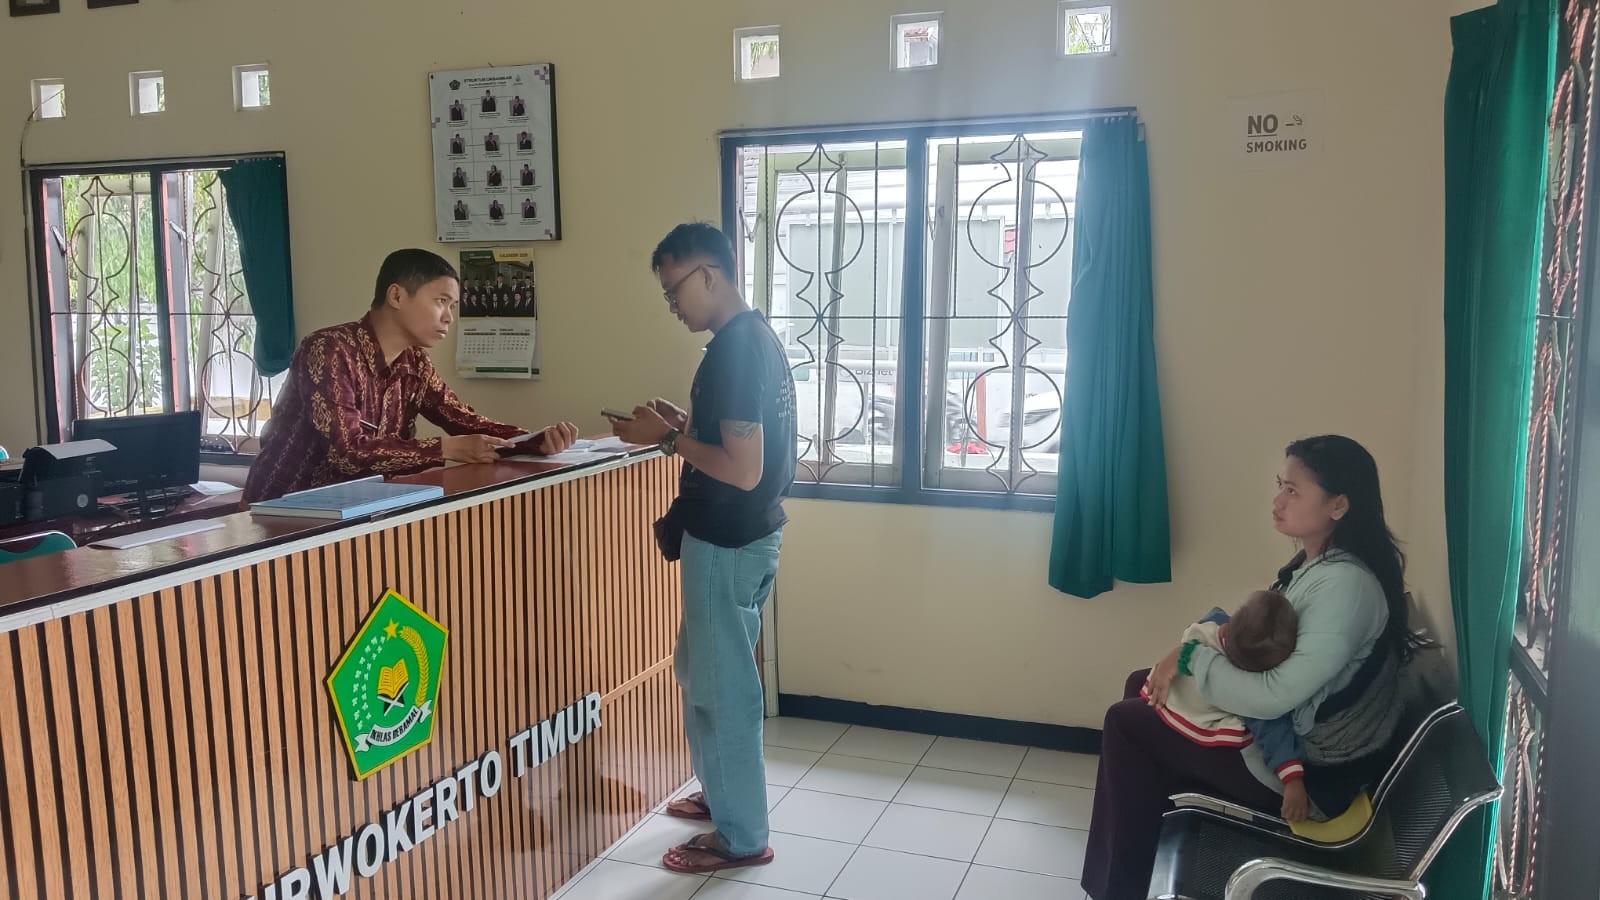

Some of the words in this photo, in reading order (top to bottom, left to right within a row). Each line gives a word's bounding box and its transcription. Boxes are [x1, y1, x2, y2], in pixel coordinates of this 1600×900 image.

[1247, 114, 1279, 135] NO
[1246, 138, 1308, 153] SMOKING
[369, 728, 392, 742] IKHLAS
[508, 691, 603, 778] TIMUR
